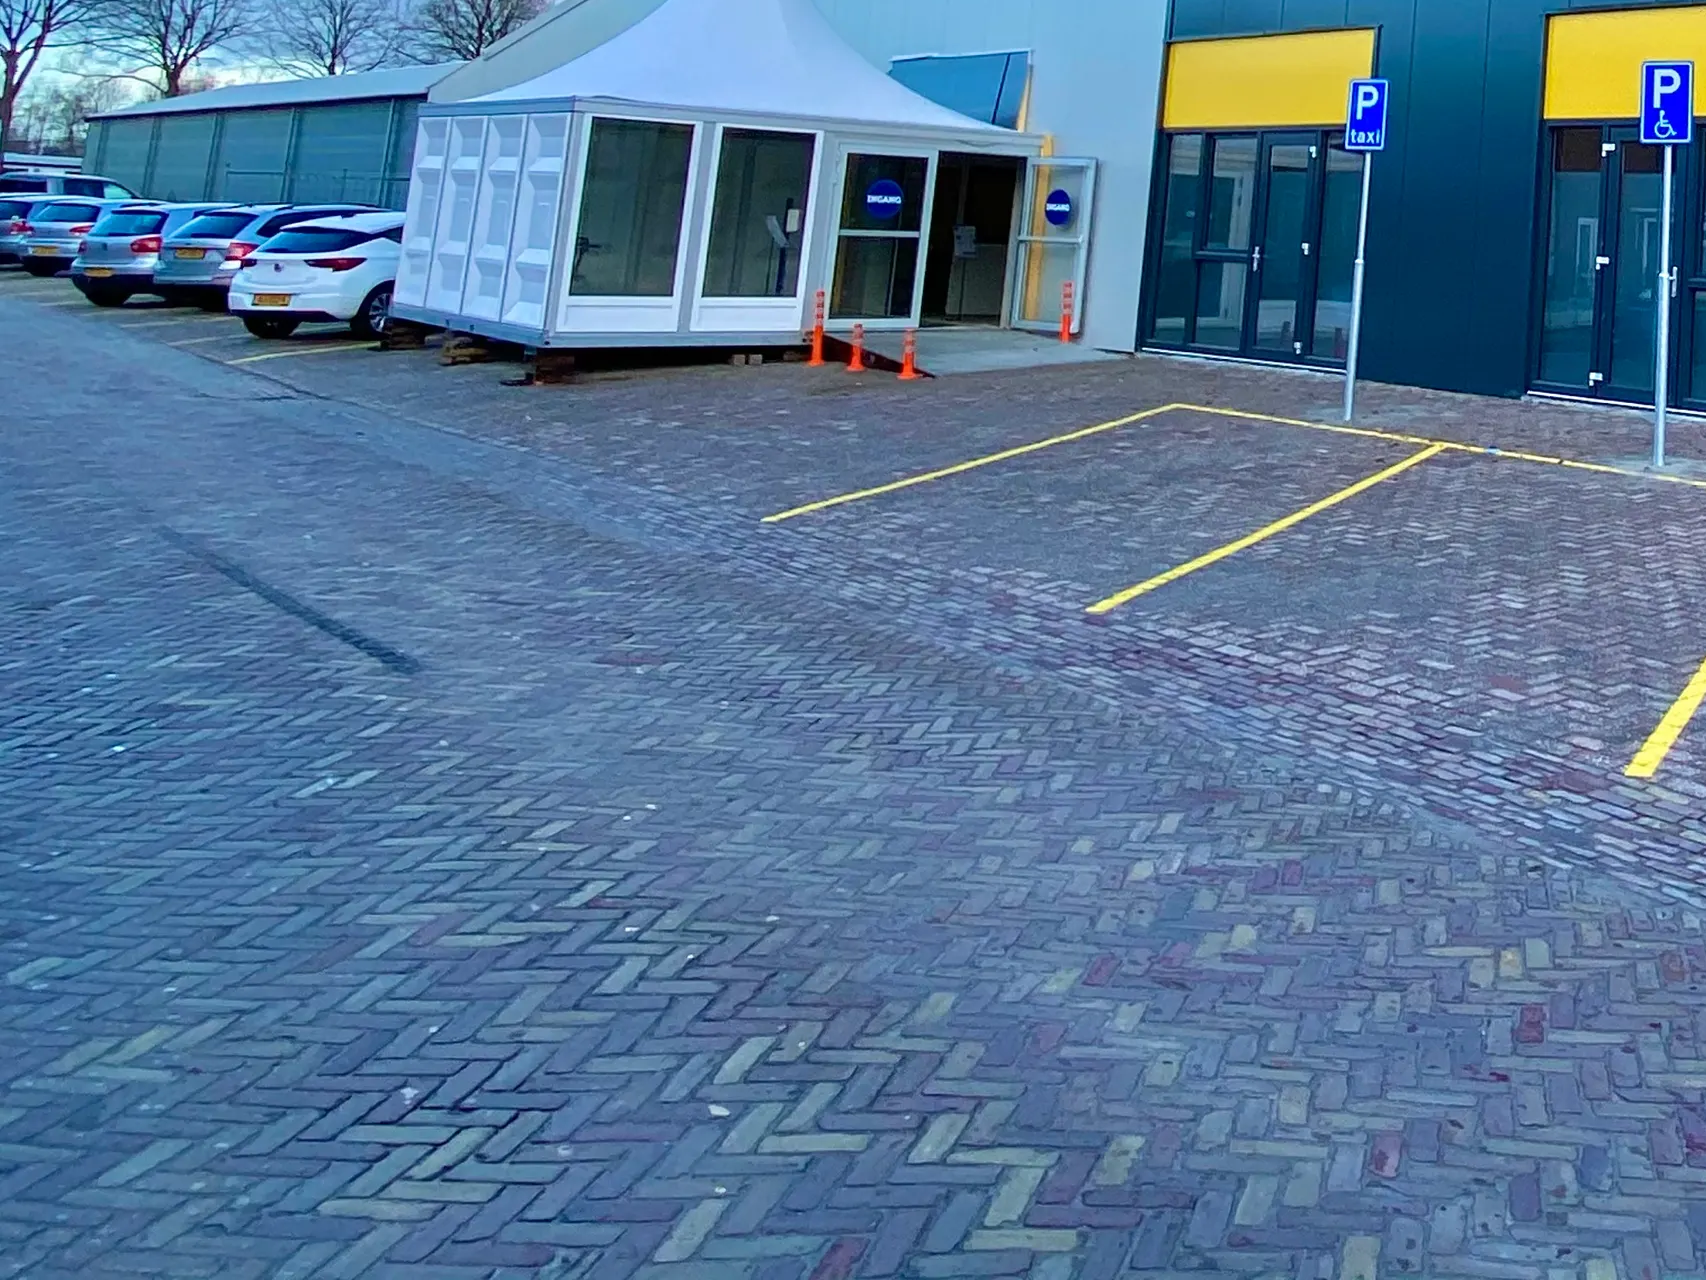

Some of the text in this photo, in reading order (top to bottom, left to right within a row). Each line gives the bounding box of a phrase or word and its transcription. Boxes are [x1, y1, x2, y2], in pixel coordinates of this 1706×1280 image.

[1653, 68, 1682, 109] P
[1356, 84, 1379, 120] P
[1350, 128, 1381, 144] taxi
[866, 194, 902, 205] INGANG
